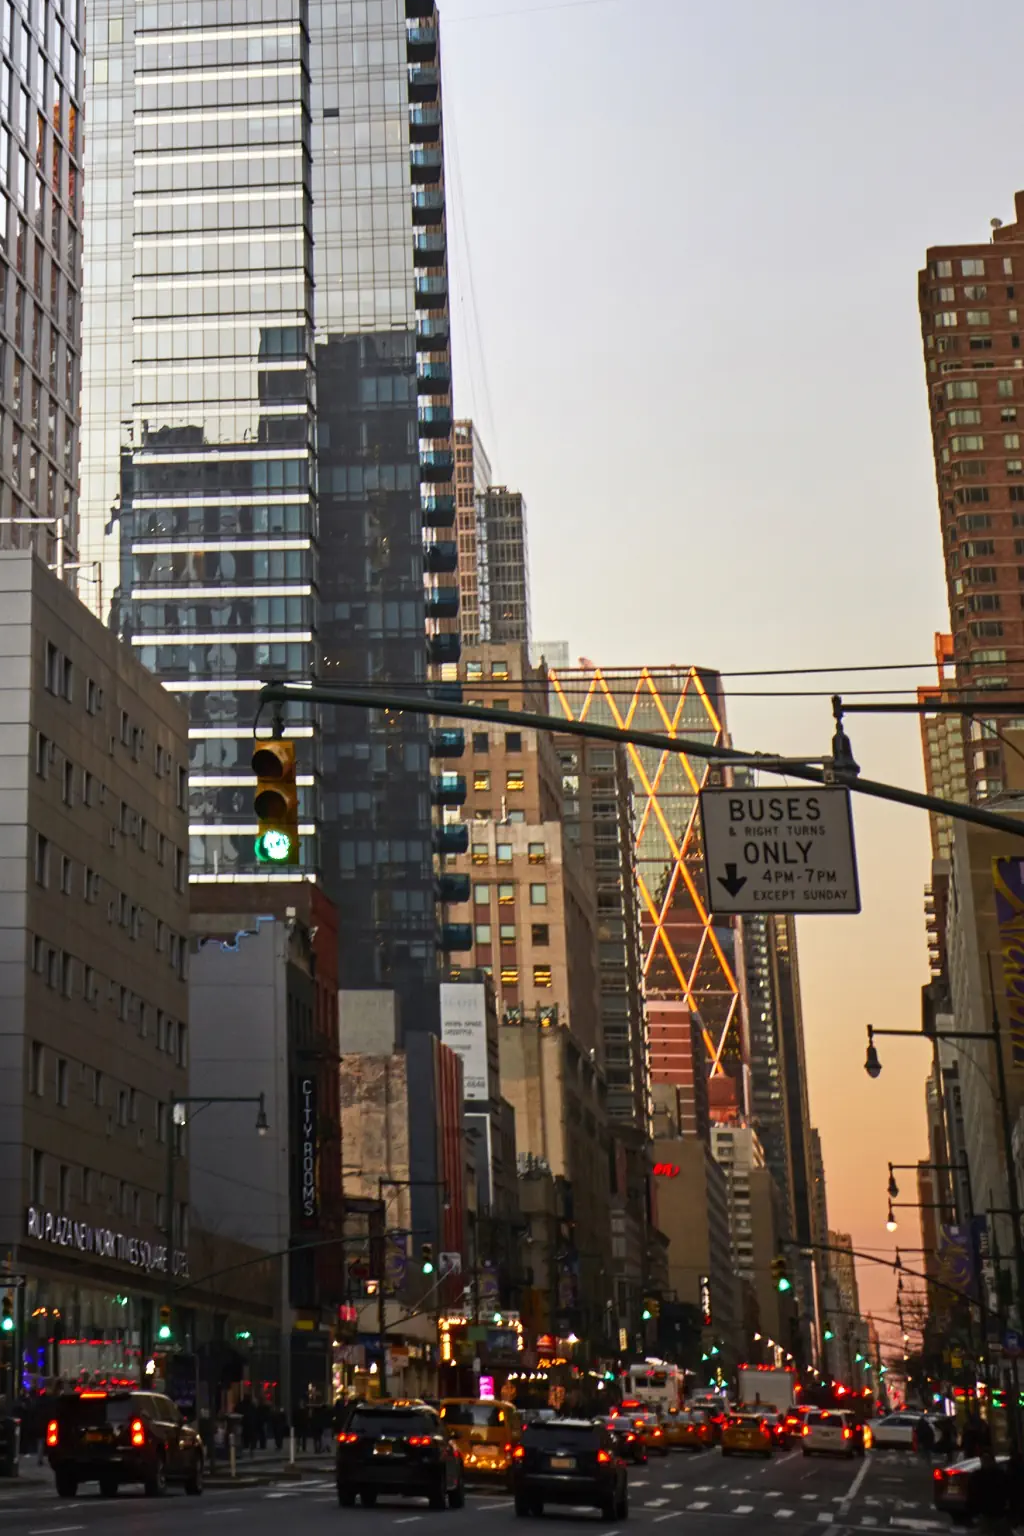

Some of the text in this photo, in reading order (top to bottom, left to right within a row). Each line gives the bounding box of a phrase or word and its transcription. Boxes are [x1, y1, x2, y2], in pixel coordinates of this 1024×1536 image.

[728, 798, 821, 822] BUSES
[729, 825, 826, 837] & RIGHT TURNS
[744, 842, 814, 865] ONLY
[753, 889, 848, 901] EXCEPT SUNDAY
[302, 1079, 315, 1217] CITY ROOMS
[45, 1212, 73, 1246] PLAZA
